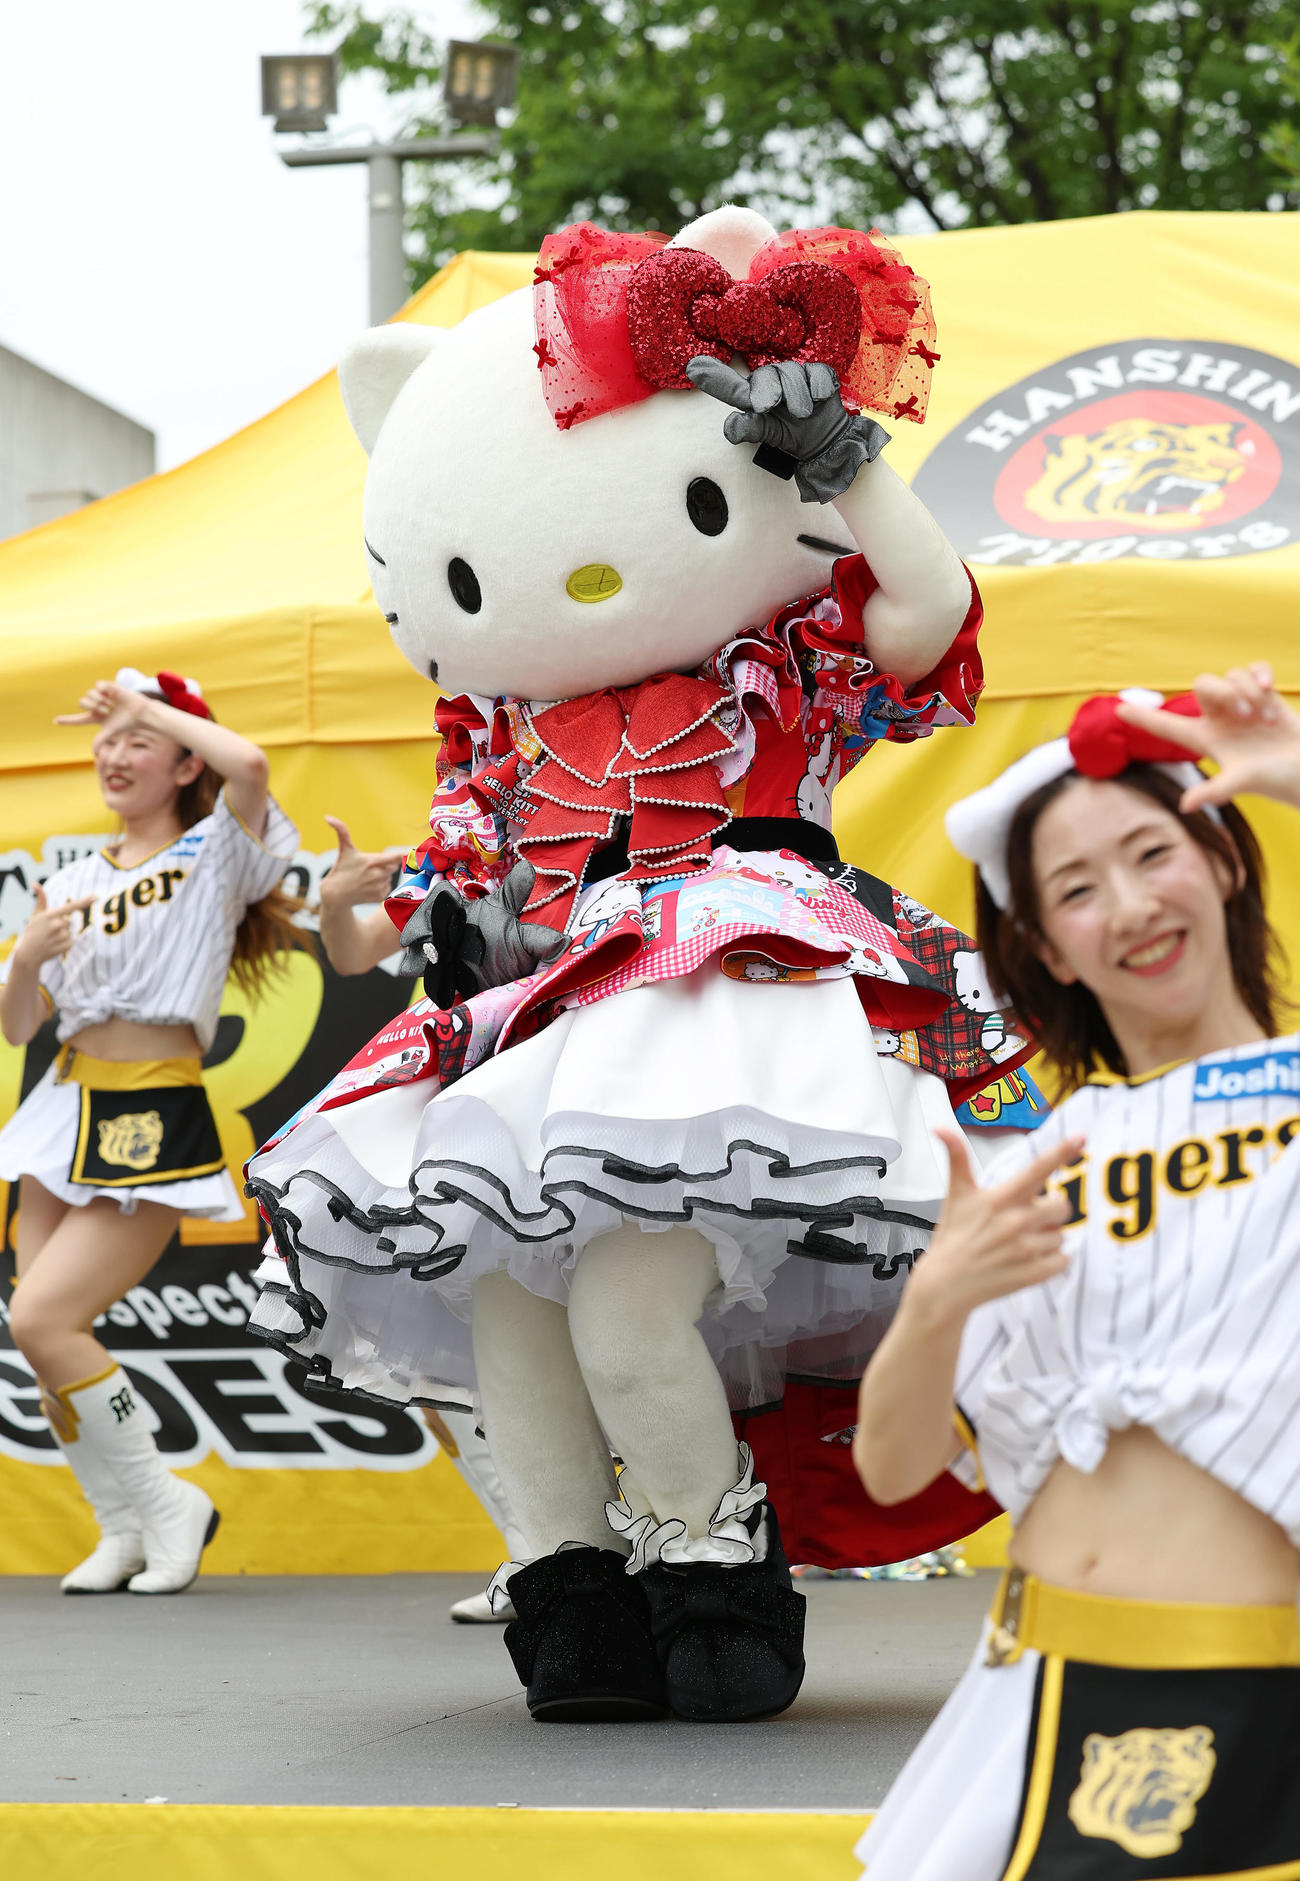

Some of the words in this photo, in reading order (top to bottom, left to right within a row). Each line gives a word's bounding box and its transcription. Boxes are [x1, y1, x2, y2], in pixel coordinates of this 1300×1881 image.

[964, 348, 1300, 452] HANSHIN
[482, 775, 513, 799] HELLO
[512, 796, 540, 815] KITT
[68, 868, 187, 935] iger
[376, 1027, 407, 1045] HELLO
[408, 1025, 423, 1038] KIT
[1195, 1057, 1300, 1097] Joshi
[1042, 1114, 1300, 1242] iger
